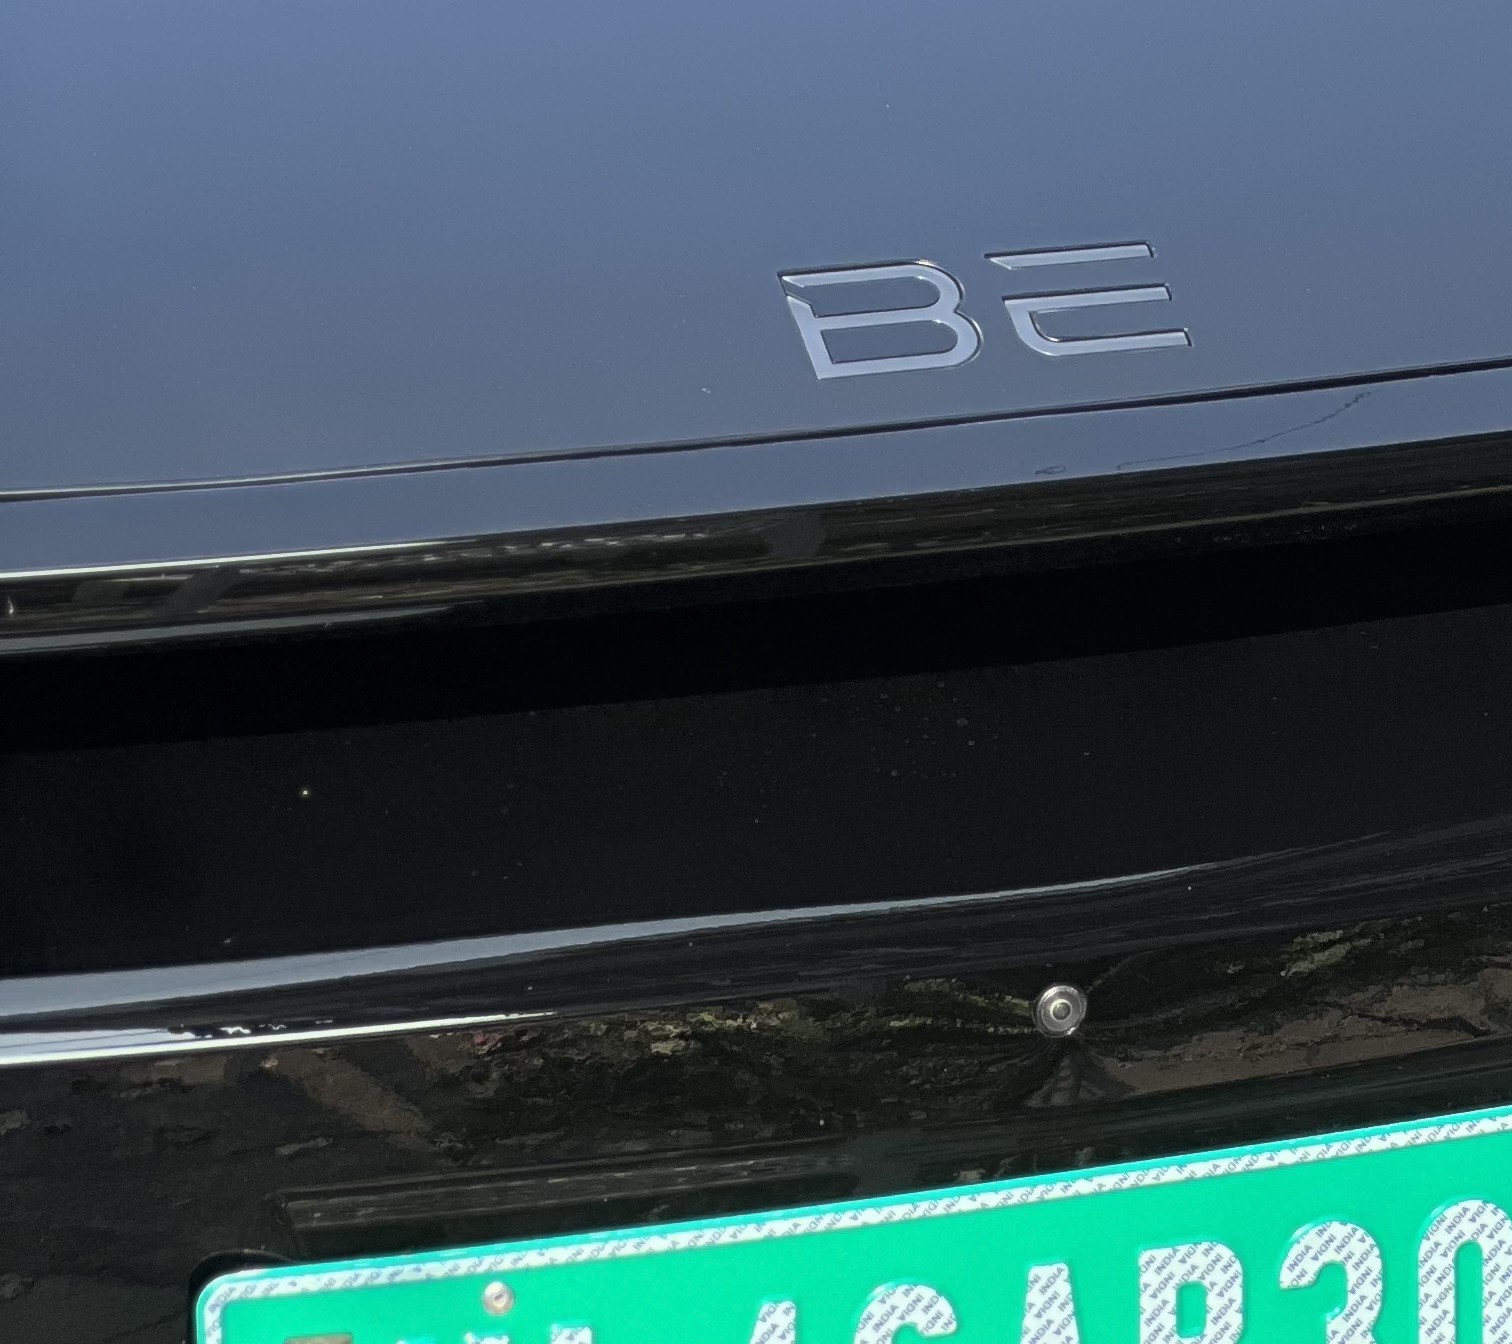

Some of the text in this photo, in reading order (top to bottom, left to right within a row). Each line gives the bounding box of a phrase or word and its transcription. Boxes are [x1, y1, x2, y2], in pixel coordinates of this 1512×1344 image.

[777, 239, 1192, 381] BE
[1445, 1206, 1470, 1234] INDIA
[1311, 1234, 1337, 1262] INDIA
[1334, 1227, 1359, 1254] INDIA
[1440, 1230, 1466, 1258] INDIA
[1154, 1247, 1180, 1275] INDIA
[1197, 1253, 1223, 1281] INDIA
[1287, 1244, 1313, 1273] INDIA
[1352, 1243, 1377, 1271] INDIA
[1039, 1267, 1065, 1295] INDIA
[1149, 1271, 1176, 1299] INDIA
[1216, 1269, 1241, 1298] INDIA
[1348, 1266, 1373, 1295] INDIA
[208, 1284, 236, 1314] INDIA
[897, 1293, 924, 1322] INDIA
[1034, 1291, 1060, 1318] INDIA
[1144, 1299, 1170, 1327] INDIA
[1210, 1297, 1237, 1326] INDIA
[1342, 1295, 1368, 1323] INDIA
[872, 1303, 900, 1333] INDIA
[1425, 1309, 1450, 1337] INDIA
